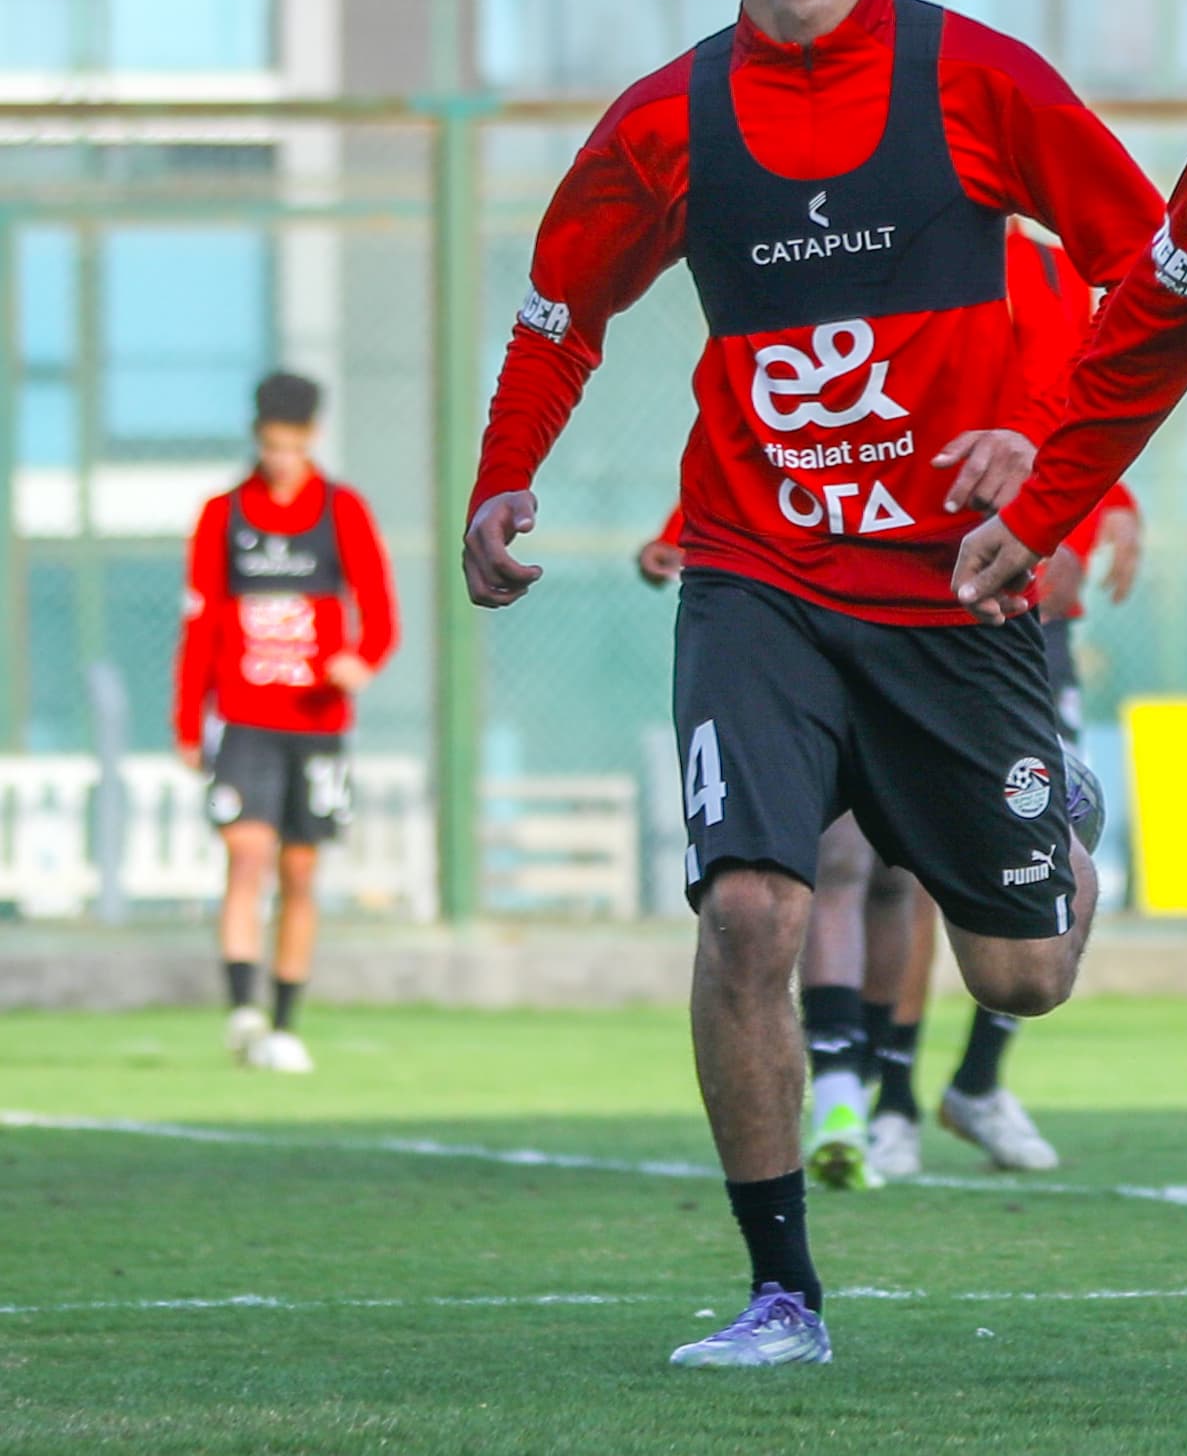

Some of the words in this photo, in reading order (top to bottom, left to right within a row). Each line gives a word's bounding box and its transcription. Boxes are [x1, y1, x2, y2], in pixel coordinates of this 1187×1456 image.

[751, 226, 896, 265] CATAPULT
[764, 441, 852, 470] tisalat
[859, 430, 914, 462] and
[686, 718, 728, 827] 4
[1002, 863, 1050, 886] PUMA
